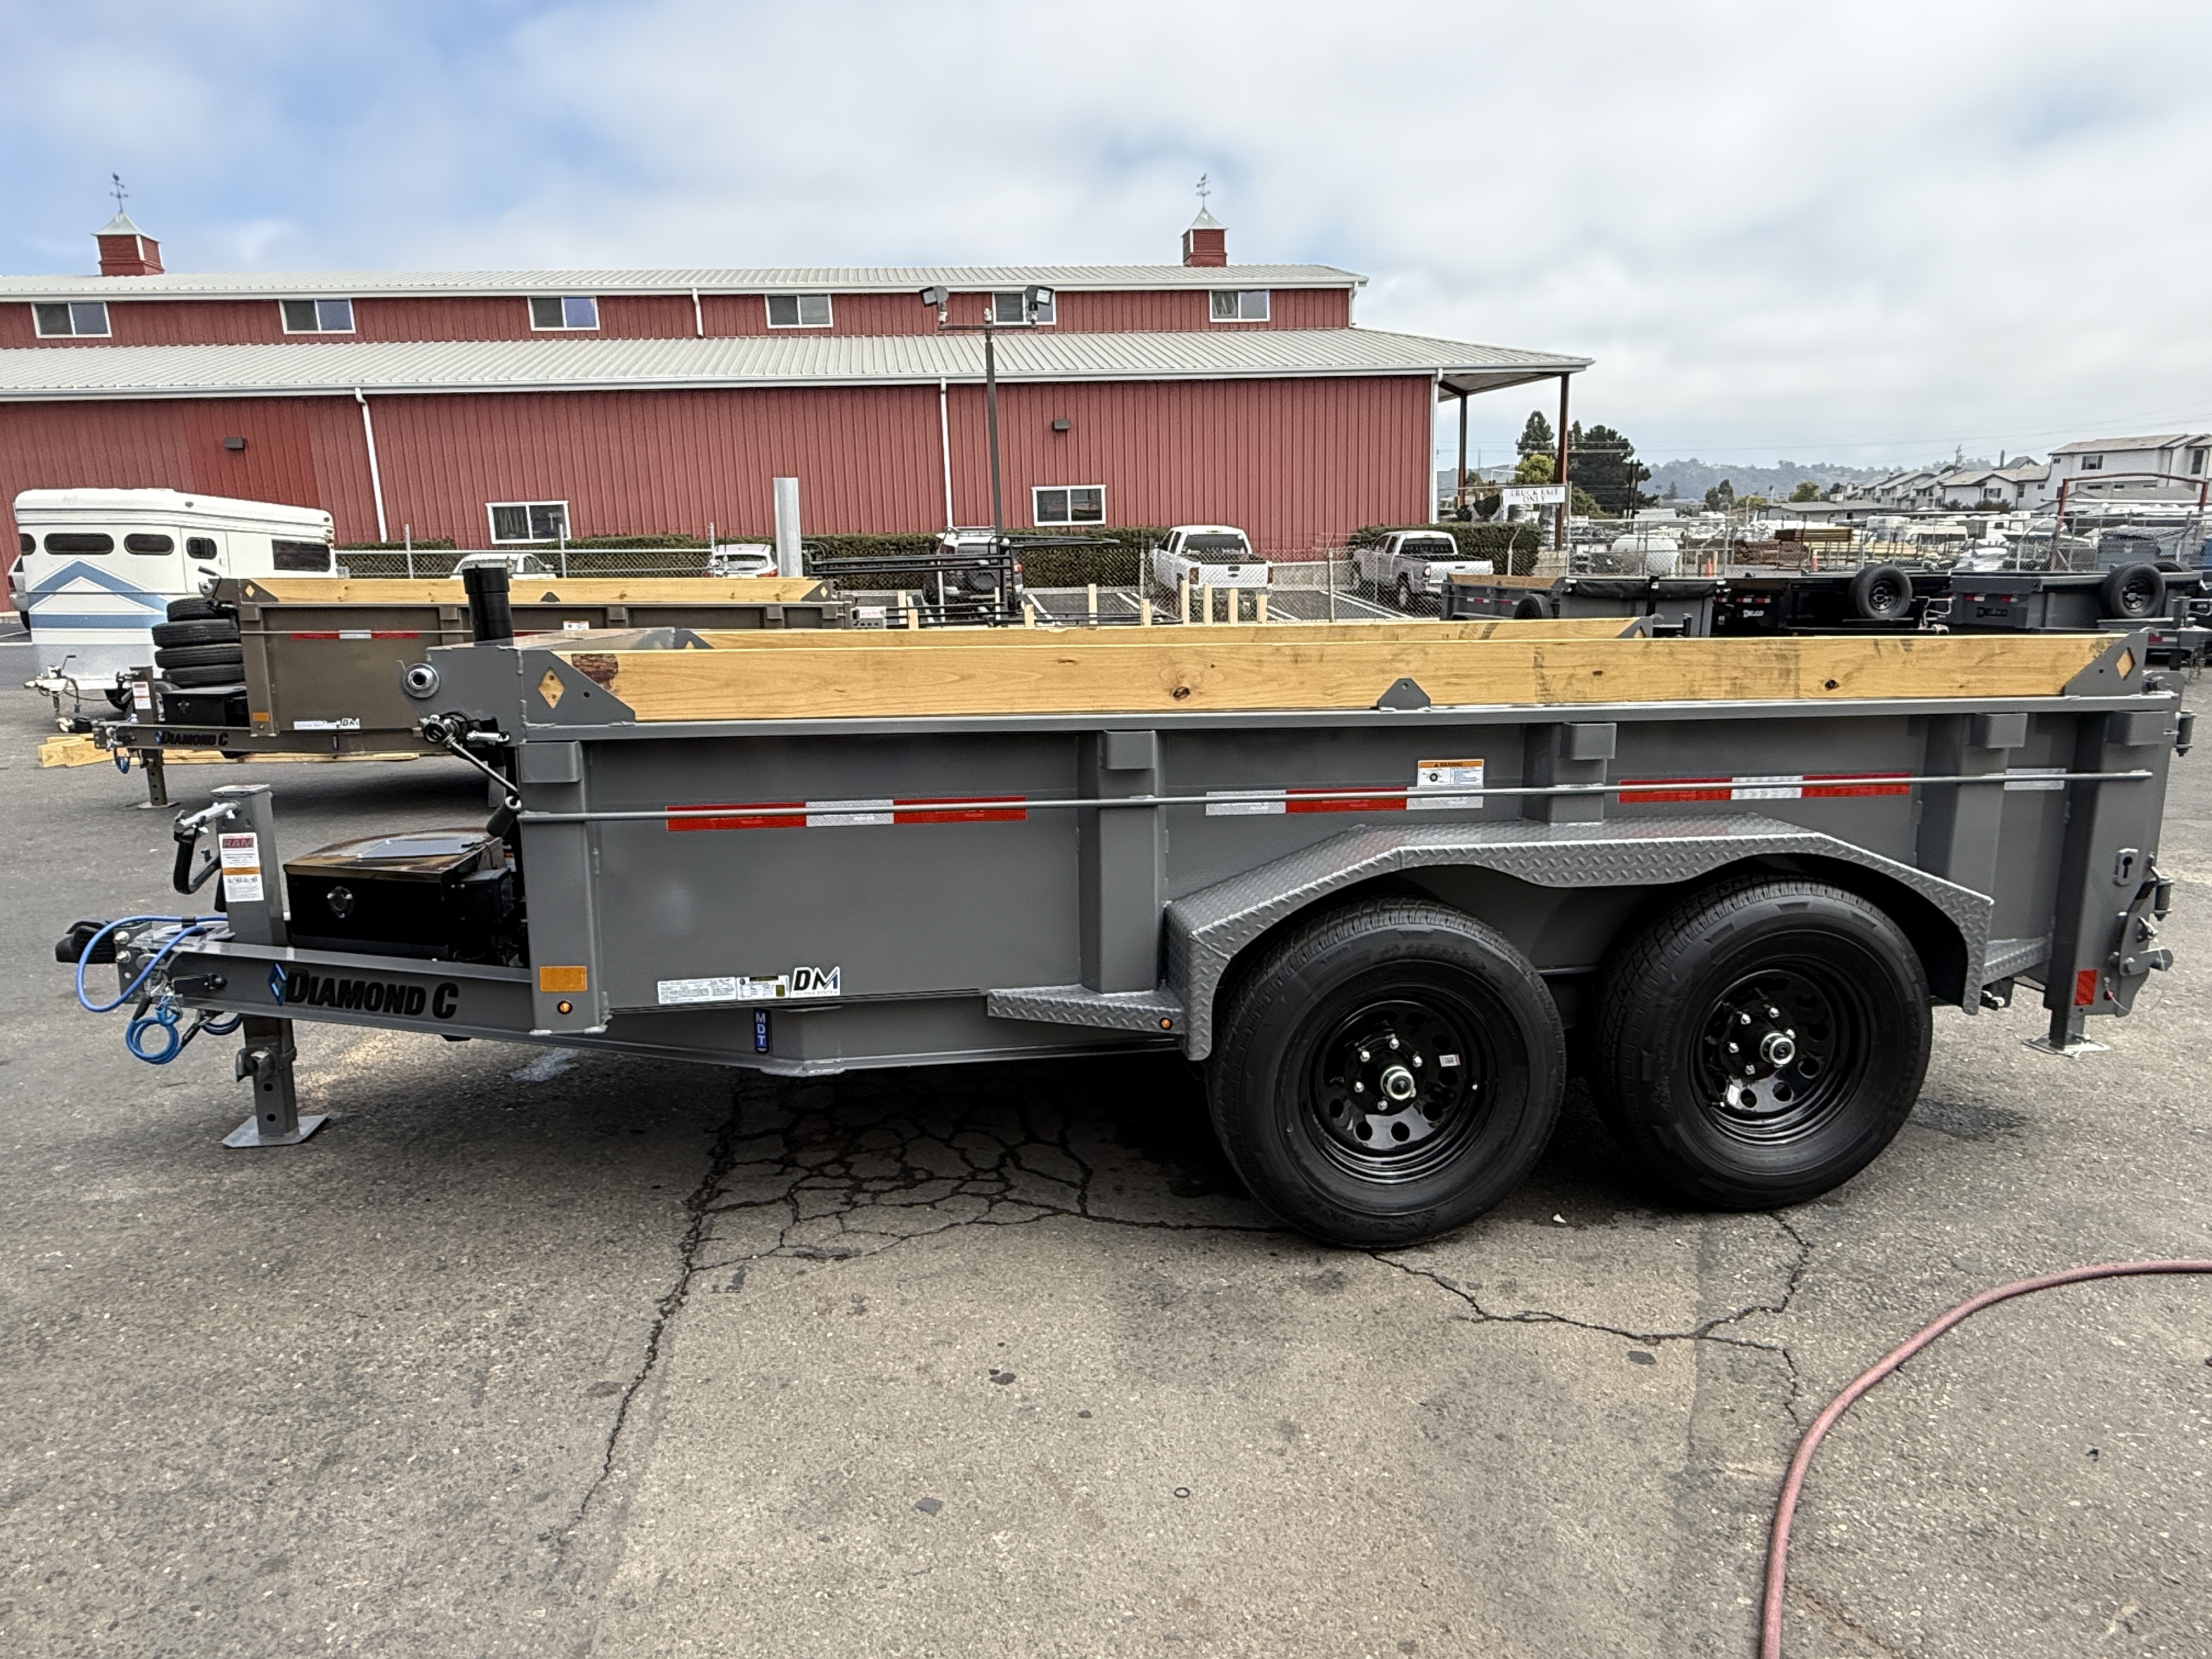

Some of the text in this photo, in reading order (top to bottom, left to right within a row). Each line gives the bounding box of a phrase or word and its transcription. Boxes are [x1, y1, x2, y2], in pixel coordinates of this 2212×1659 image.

[218, 732, 228, 746] C
[223, 838, 253, 848] RAM
[793, 968, 838, 991] DM
[285, 968, 459, 1019] DIAMOND C
[755, 1013, 766, 1047] MDT
